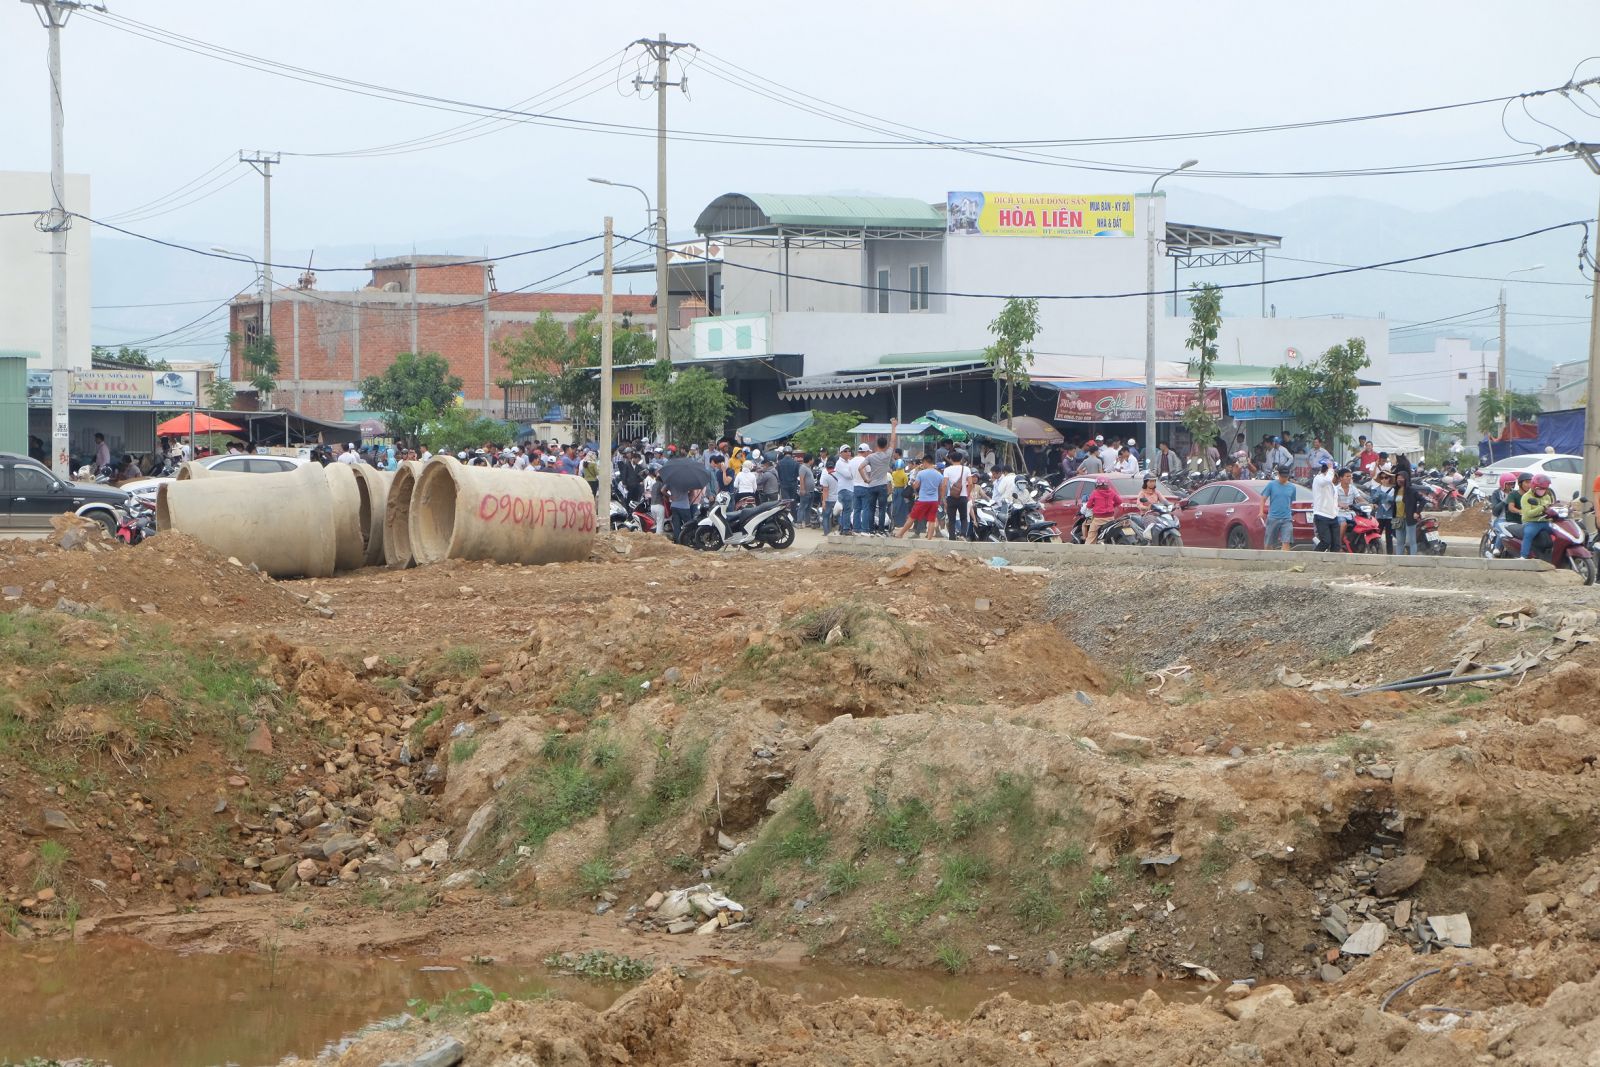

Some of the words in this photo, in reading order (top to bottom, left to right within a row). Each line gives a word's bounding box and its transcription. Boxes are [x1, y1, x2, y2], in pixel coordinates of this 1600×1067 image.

[999, 204, 1037, 227] HÒA
[1042, 207, 1083, 228] LIÊN
[479, 493, 595, 533] 0901179898
